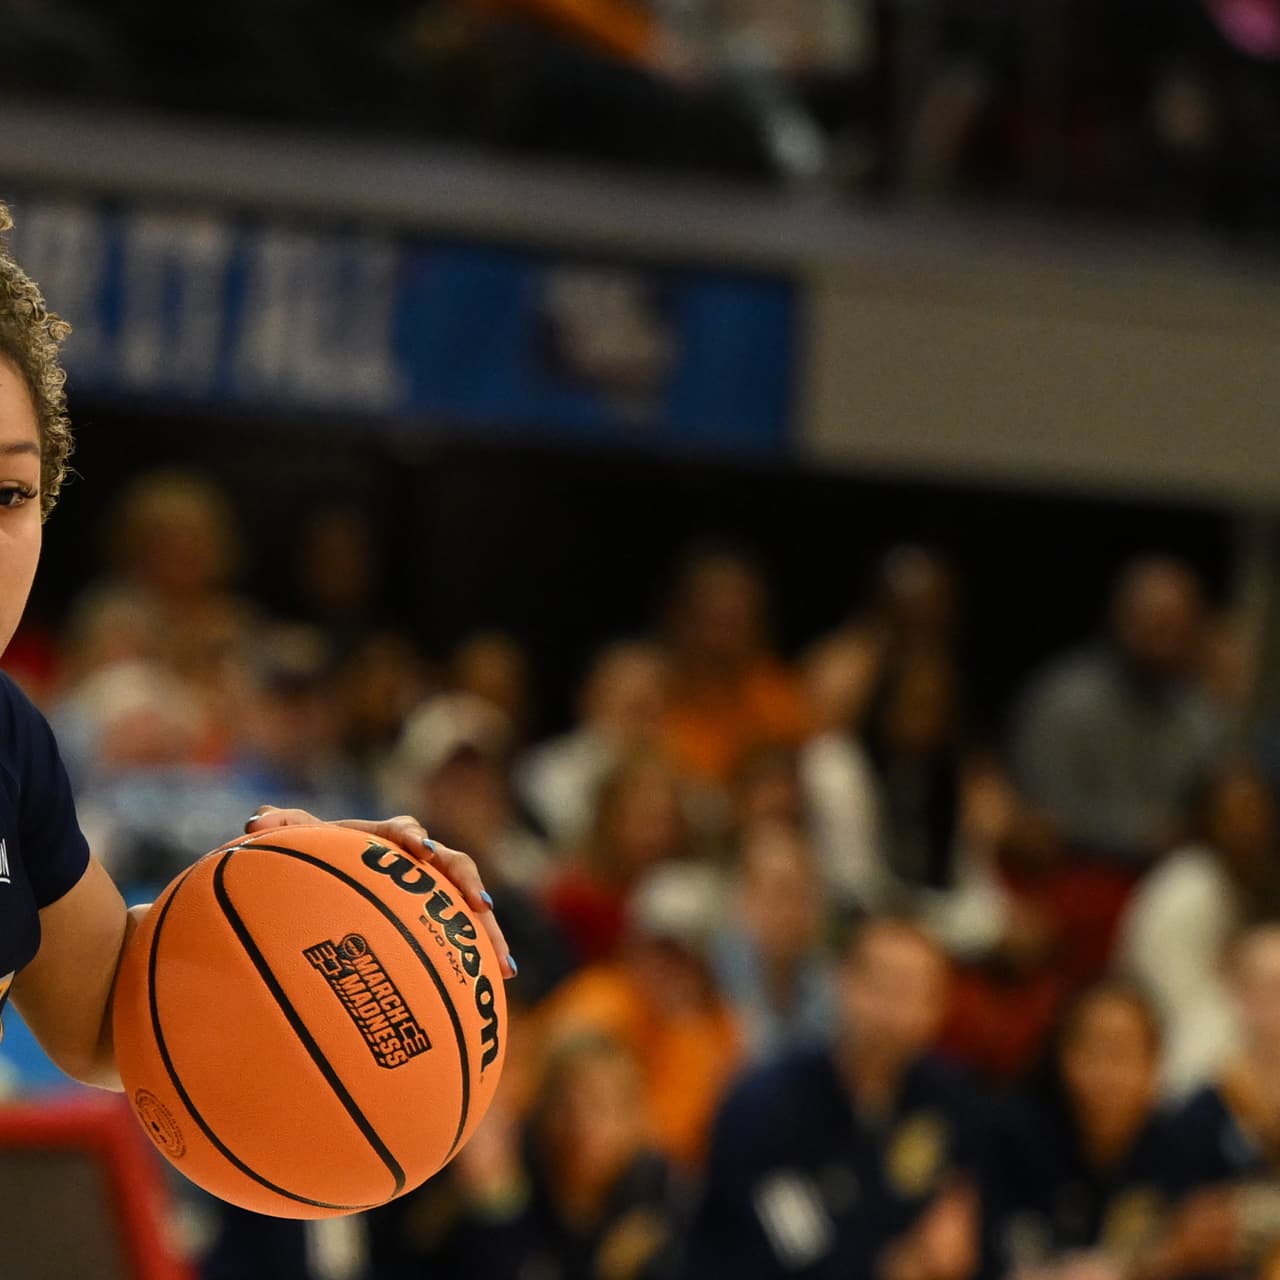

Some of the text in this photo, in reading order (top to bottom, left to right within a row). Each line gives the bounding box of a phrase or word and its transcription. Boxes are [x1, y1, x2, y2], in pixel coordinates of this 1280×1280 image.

[419, 915, 467, 986] EVO NXT
[338, 973, 407, 1067] MADNESS
[352, 954, 411, 1024] MARCH
